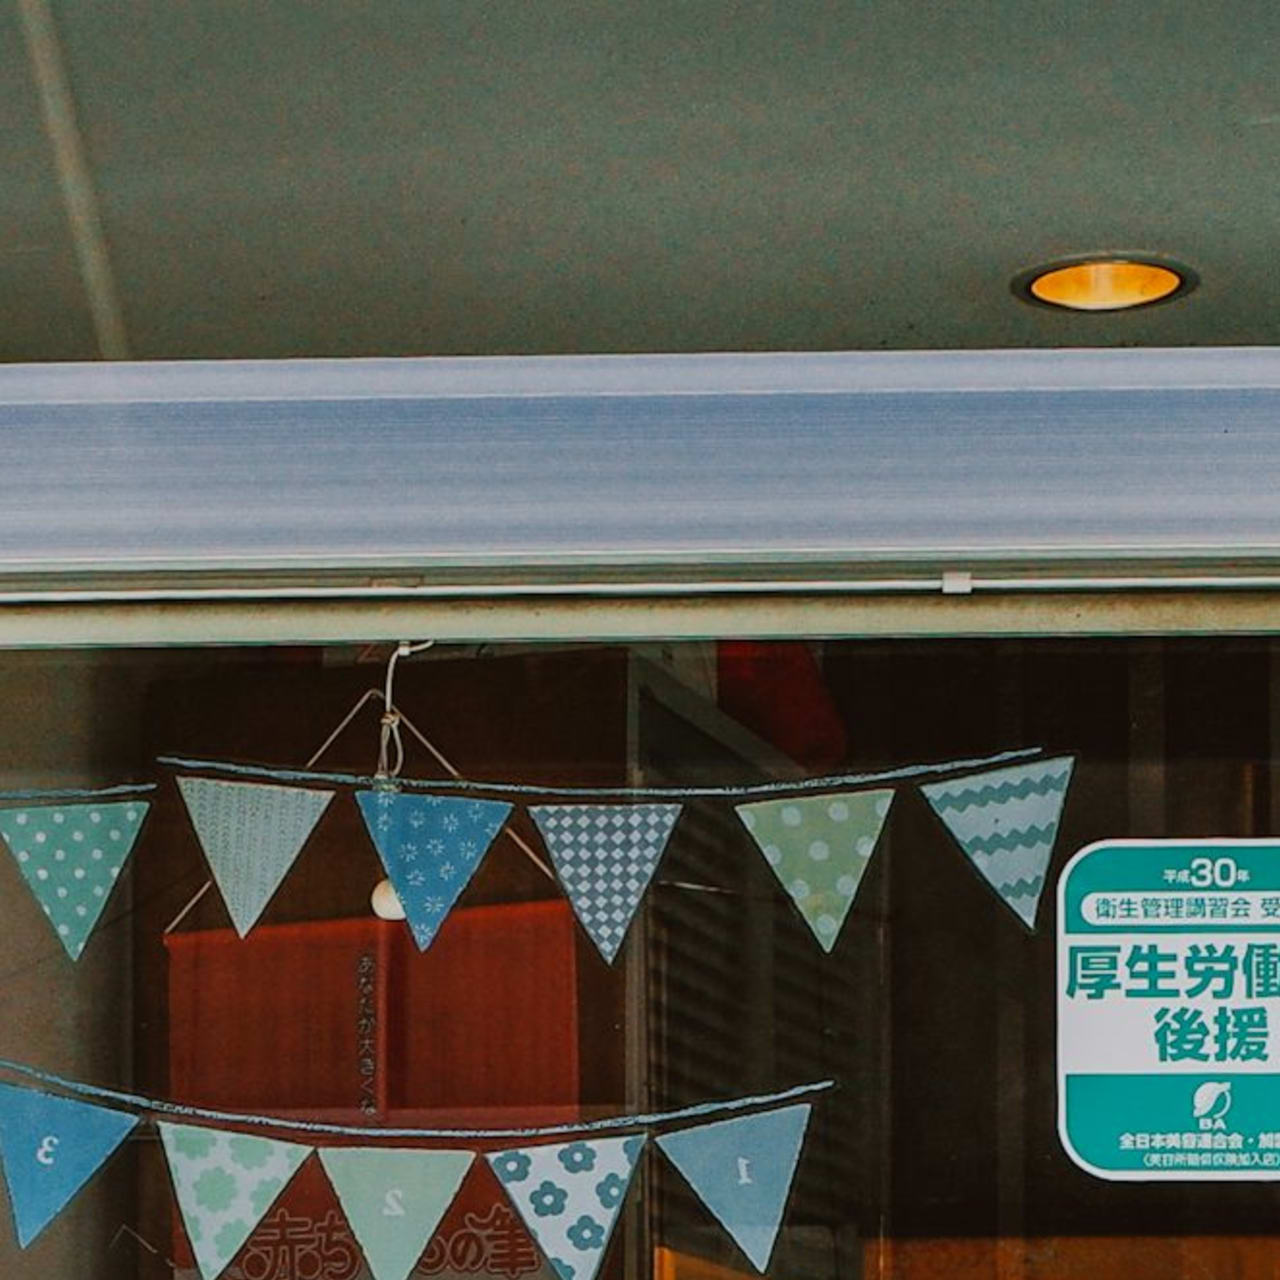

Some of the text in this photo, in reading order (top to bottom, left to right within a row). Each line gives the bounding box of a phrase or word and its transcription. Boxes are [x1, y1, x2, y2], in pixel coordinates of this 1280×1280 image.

[1164, 858, 1249, 888] 平成30年
[1095, 897, 1252, 919] 衛生管理講習会
[1154, 1006, 1269, 1062] 後援
[1198, 1118, 1227, 1130] BA
